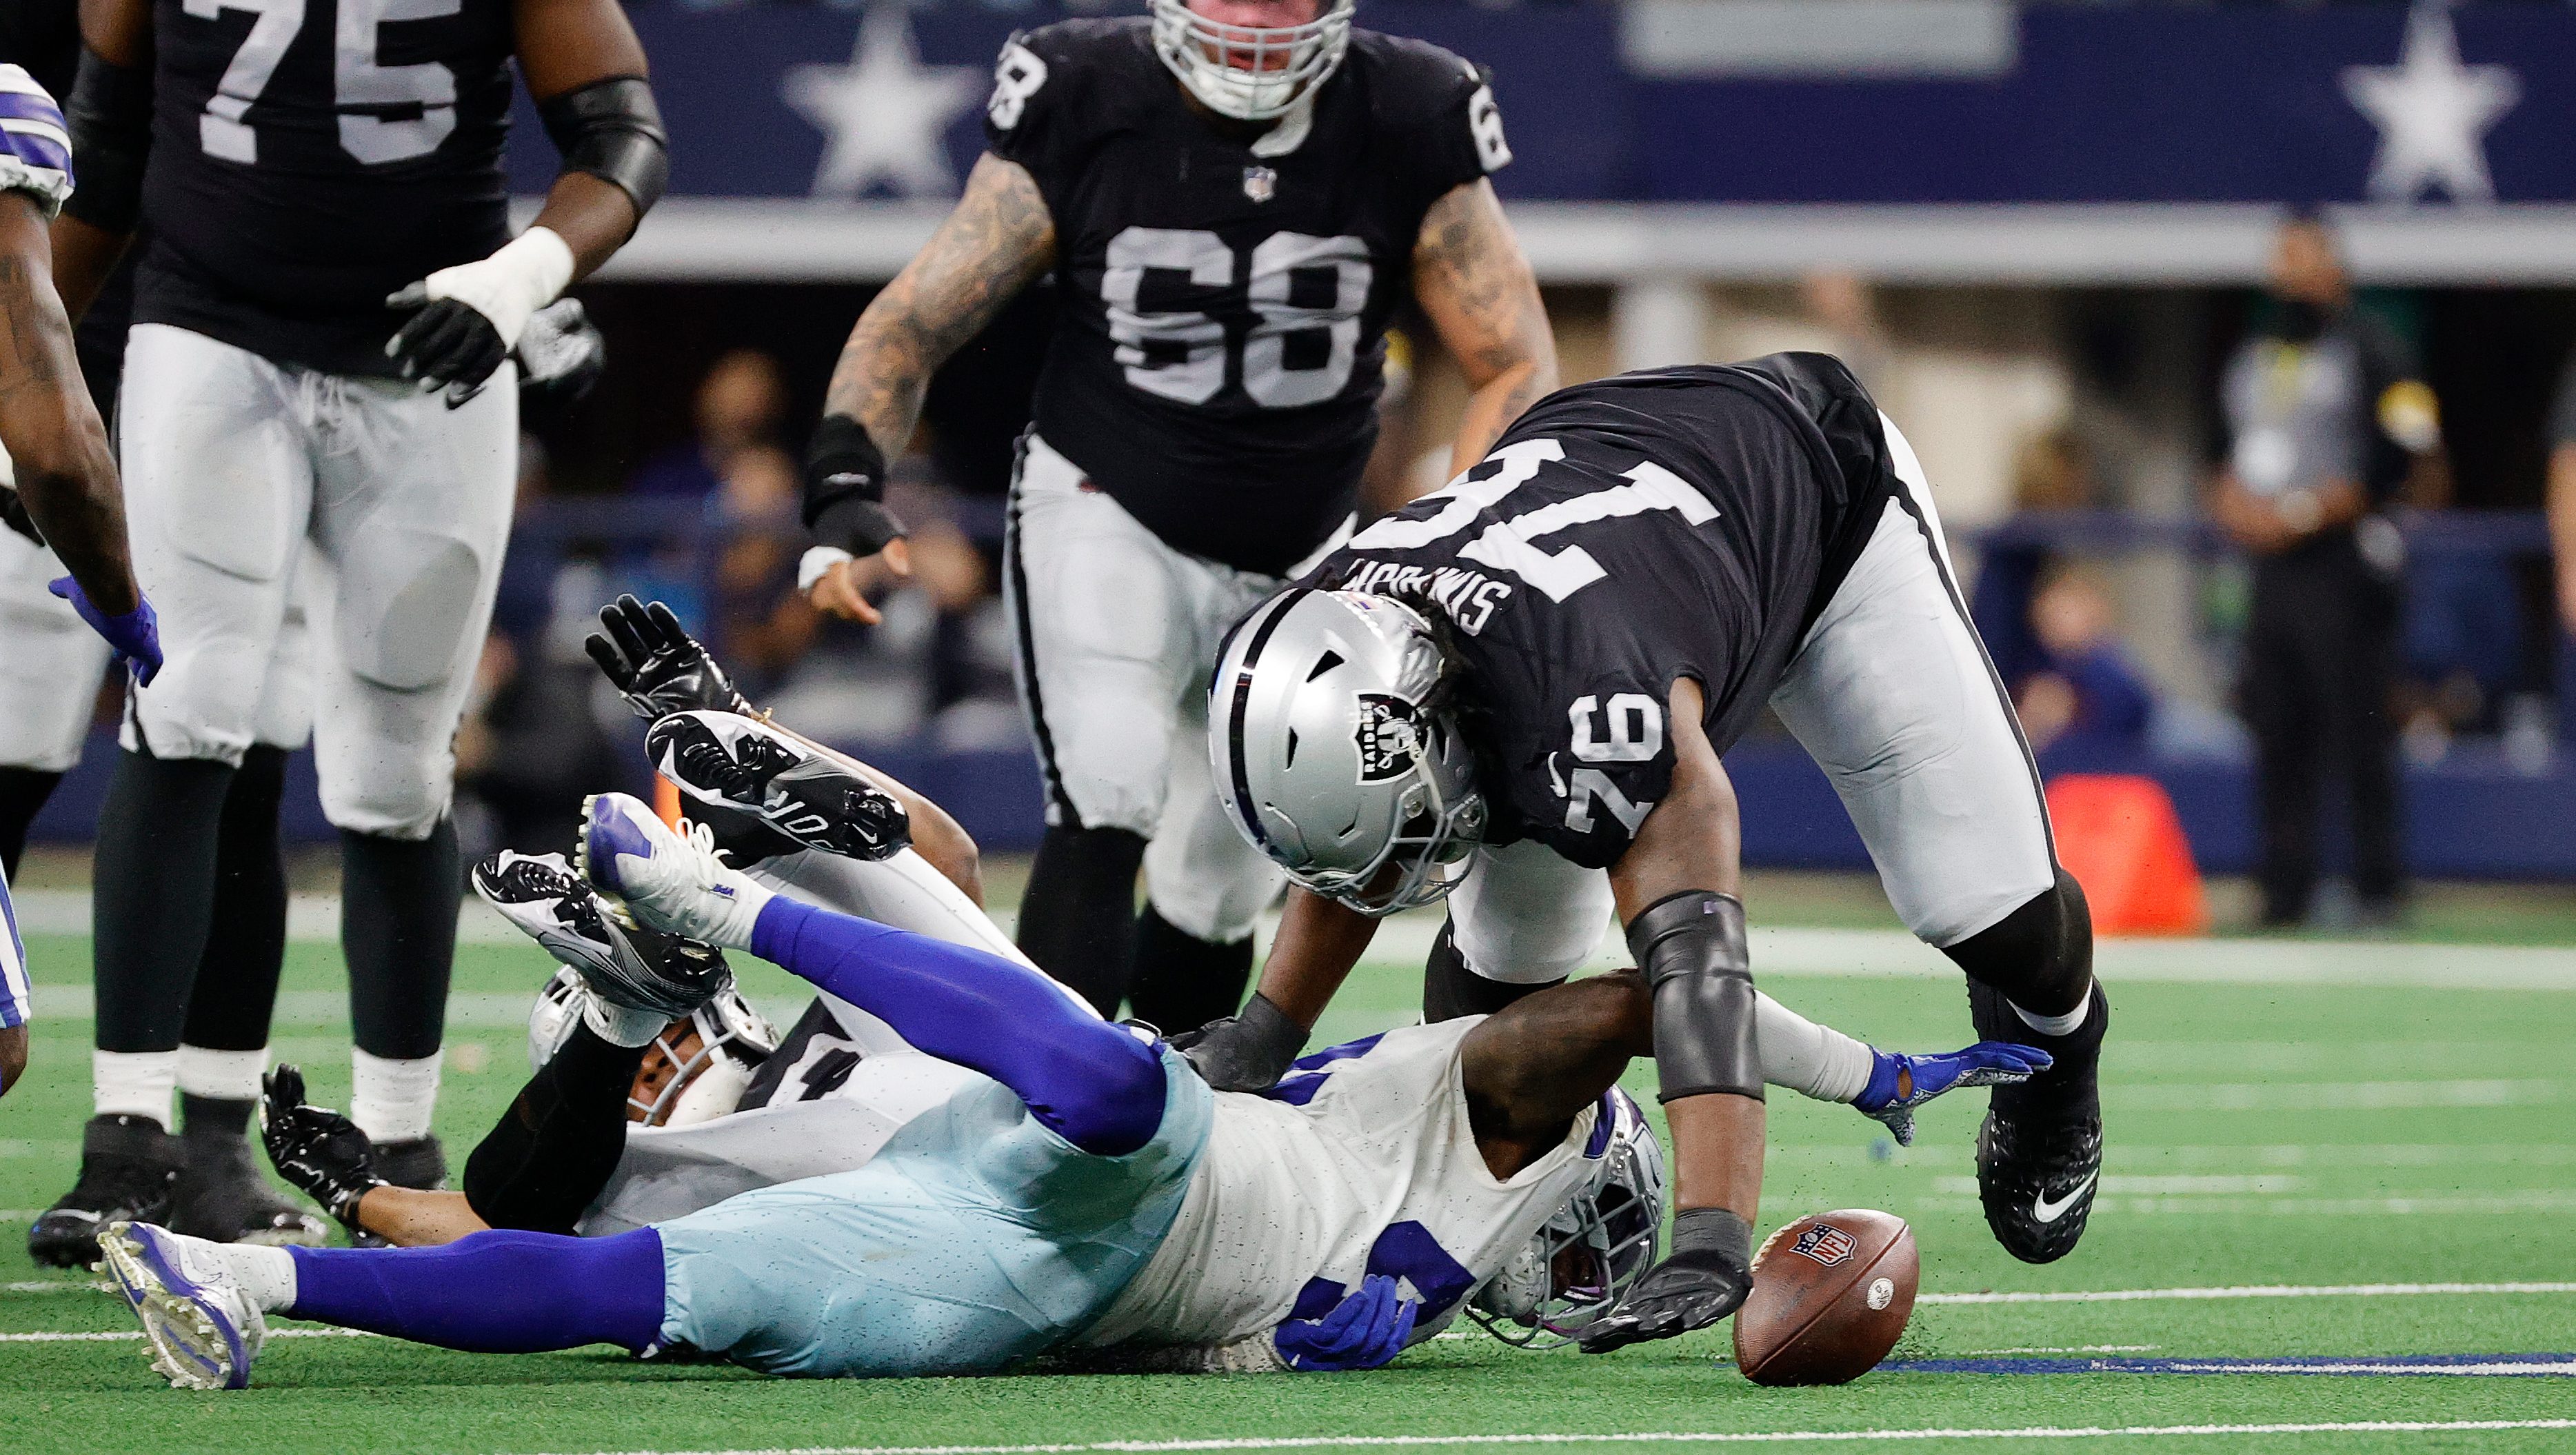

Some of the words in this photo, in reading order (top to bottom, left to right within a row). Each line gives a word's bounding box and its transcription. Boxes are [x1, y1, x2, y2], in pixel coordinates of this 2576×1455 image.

[183, 0, 461, 165] 75
[1101, 226, 1373, 409] 68
[1564, 692, 1663, 840] 76
[1812, 1233, 1852, 1262] NFL
